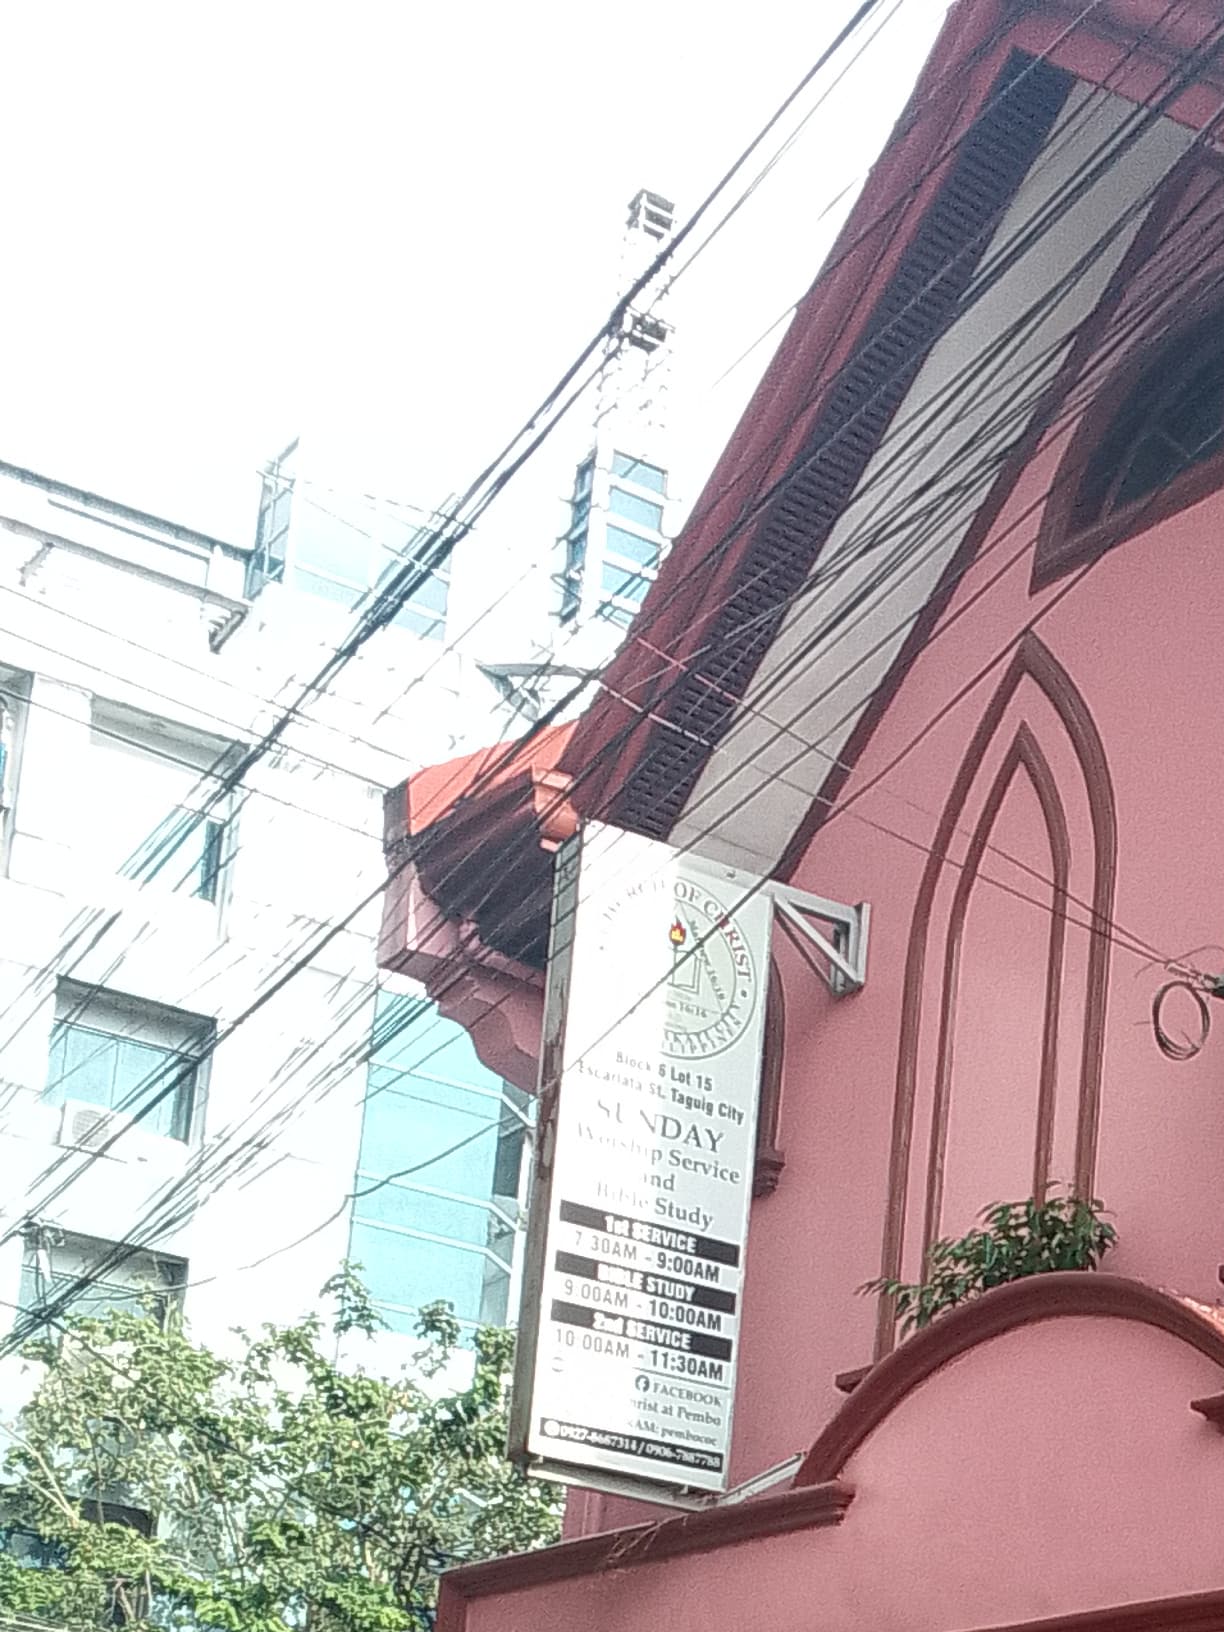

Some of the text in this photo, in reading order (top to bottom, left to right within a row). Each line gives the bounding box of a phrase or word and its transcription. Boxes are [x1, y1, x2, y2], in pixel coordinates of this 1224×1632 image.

[674, 881, 700, 902] OF
[616, 1051, 651, 1072] Block
[670, 1066, 691, 1087] Lot
[696, 1074, 713, 1092] 15
[670, 1087, 714, 1117] Taguig
[718, 1102, 745, 1126] City
[668, 1148, 740, 1185] Service
[654, 1195, 714, 1232] Study
[604, 1214, 697, 1254] 1st SERVICE
[574, 1229, 638, 1261] 730AM
[656, 1251, 721, 1284] 9:00AM
[564, 1277, 629, 1310] 900AM
[649, 1298, 723, 1333] 10:00AM
[646, 1275, 697, 1302] STUDY
[592, 1311, 692, 1351] 2nd SERVICE
[556, 1327, 631, 1360] 1000AM
[650, 1349, 724, 1382] 11:30AM
[652, 1381, 723, 1408] FACEBOOK
